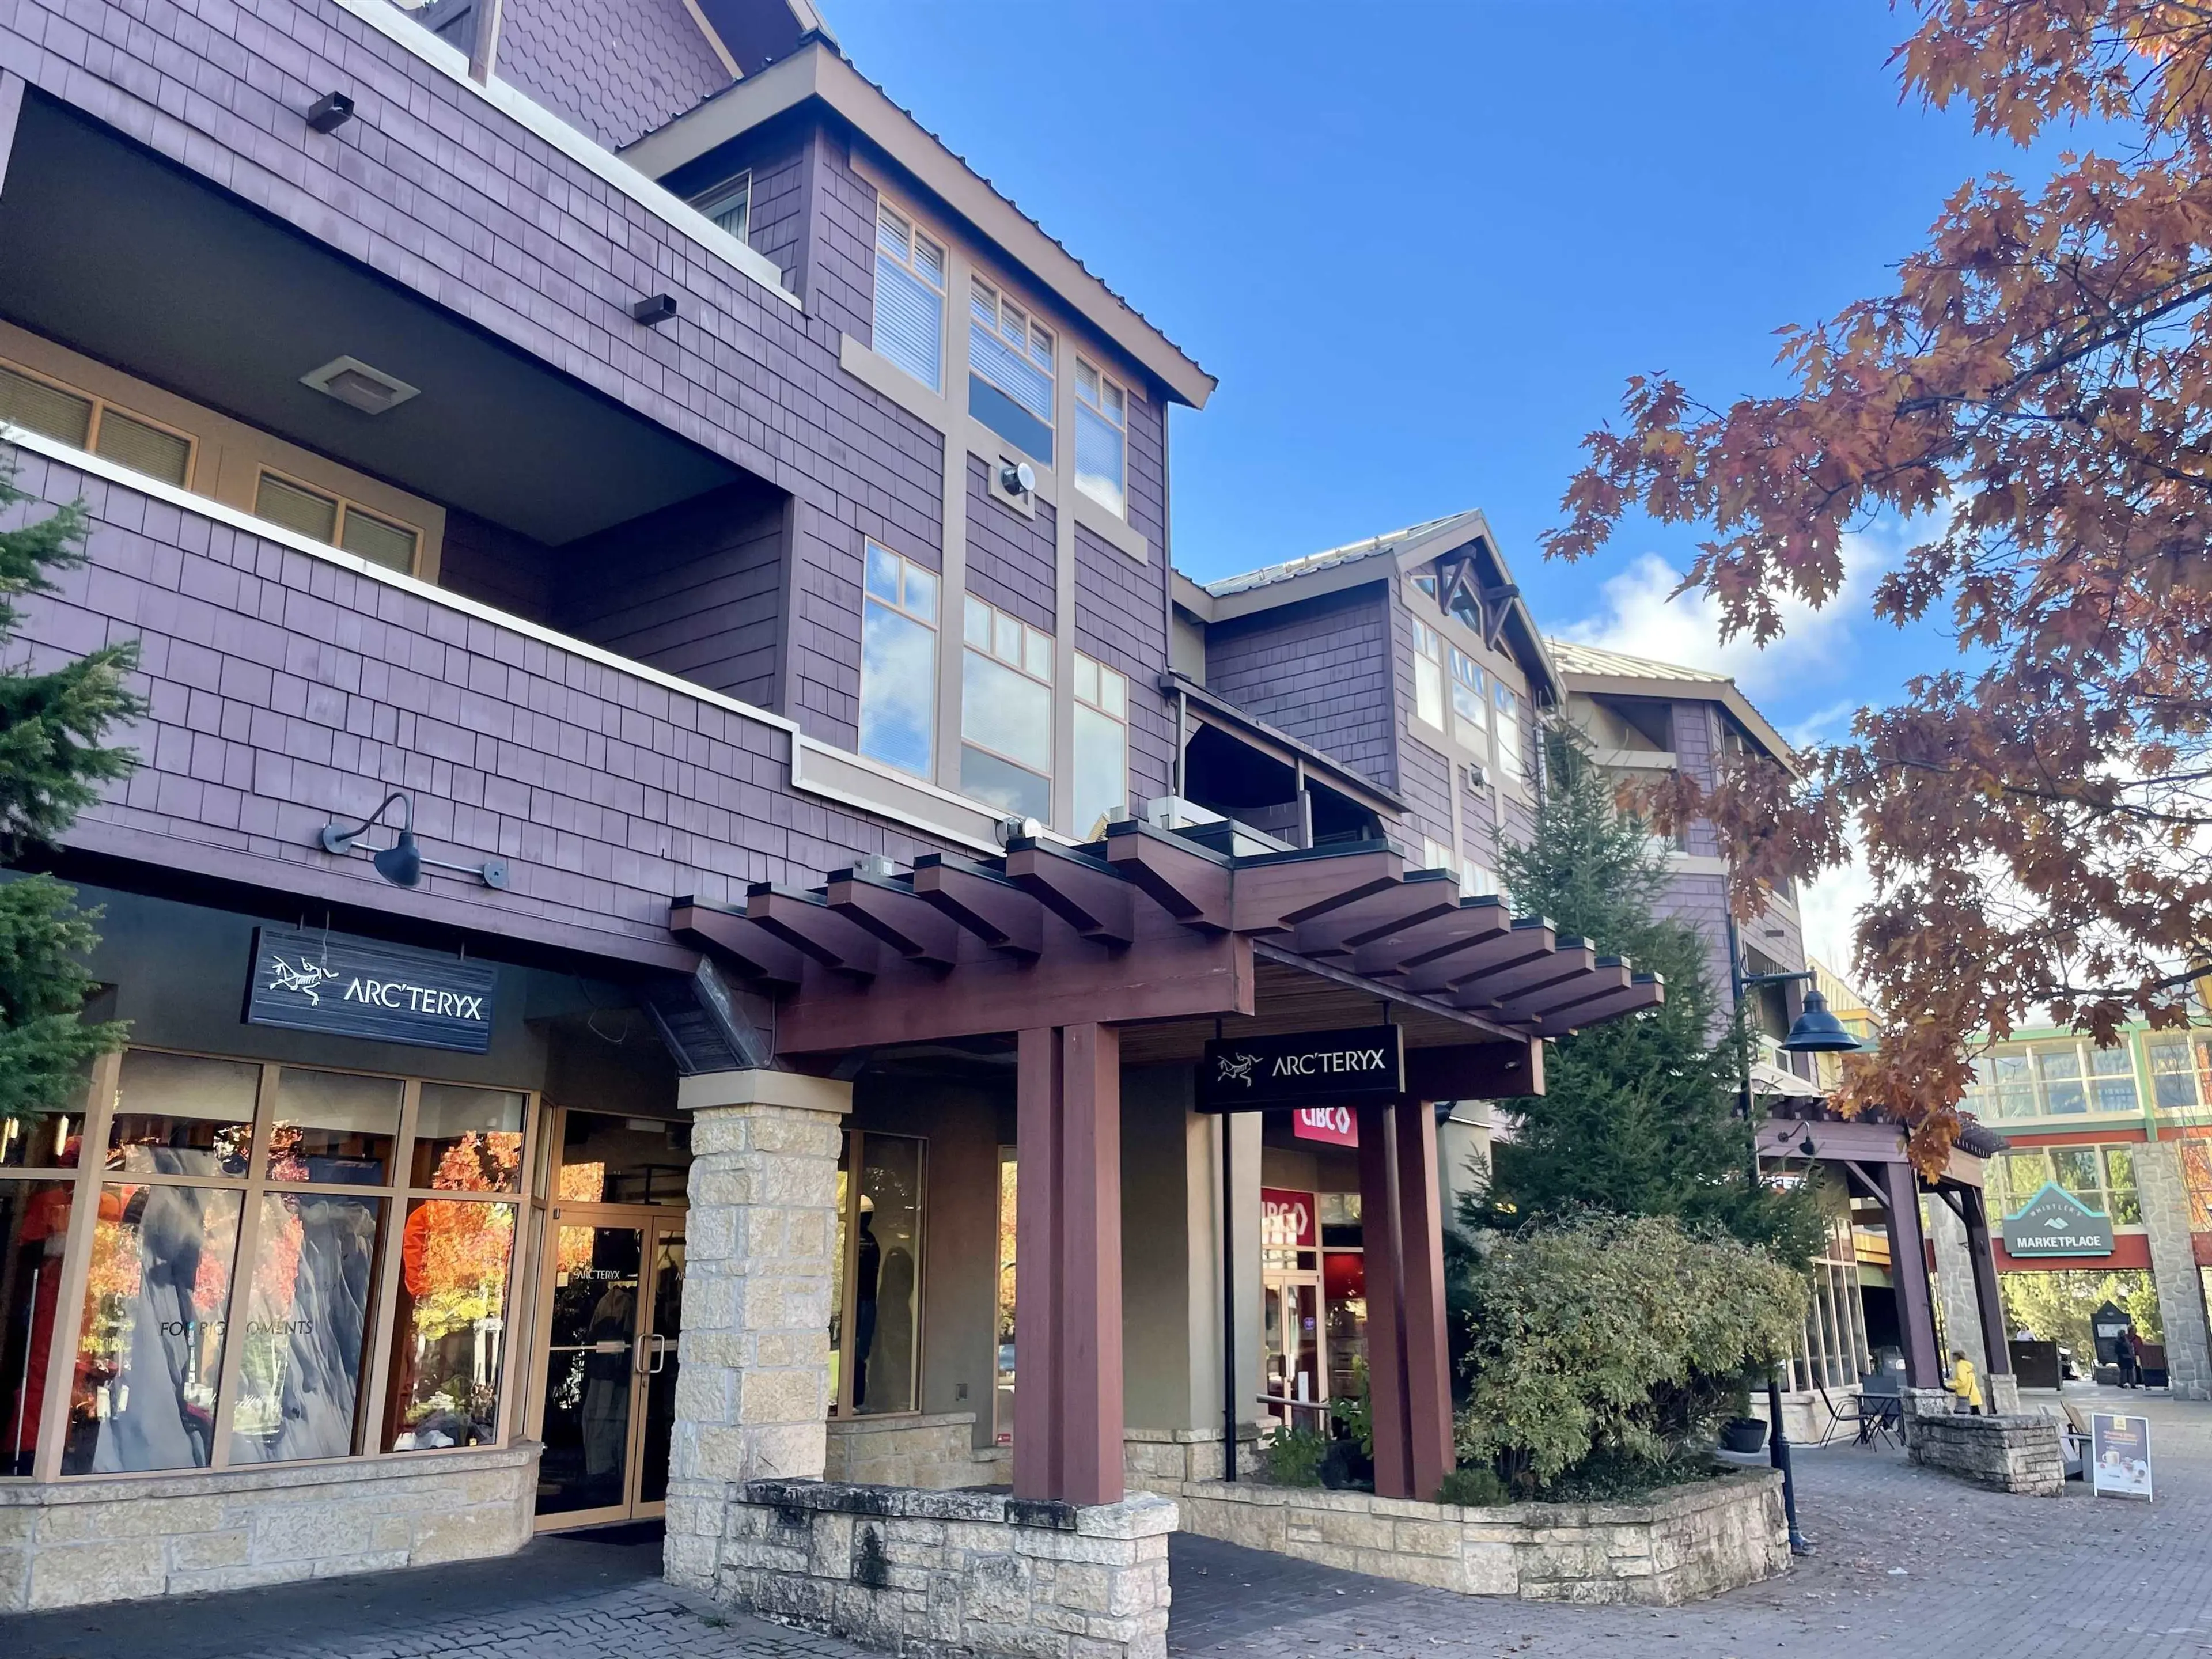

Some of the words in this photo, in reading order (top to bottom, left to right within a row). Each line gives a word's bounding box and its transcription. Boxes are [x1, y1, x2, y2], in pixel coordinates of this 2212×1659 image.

[344, 977, 483, 1020] ARC'TERYX
[1272, 1048, 1386, 1077] ARC'TERYX
[2017, 1236, 2102, 1248] MARKETPLACE
[247, 1320, 313, 1335] OMENTS
